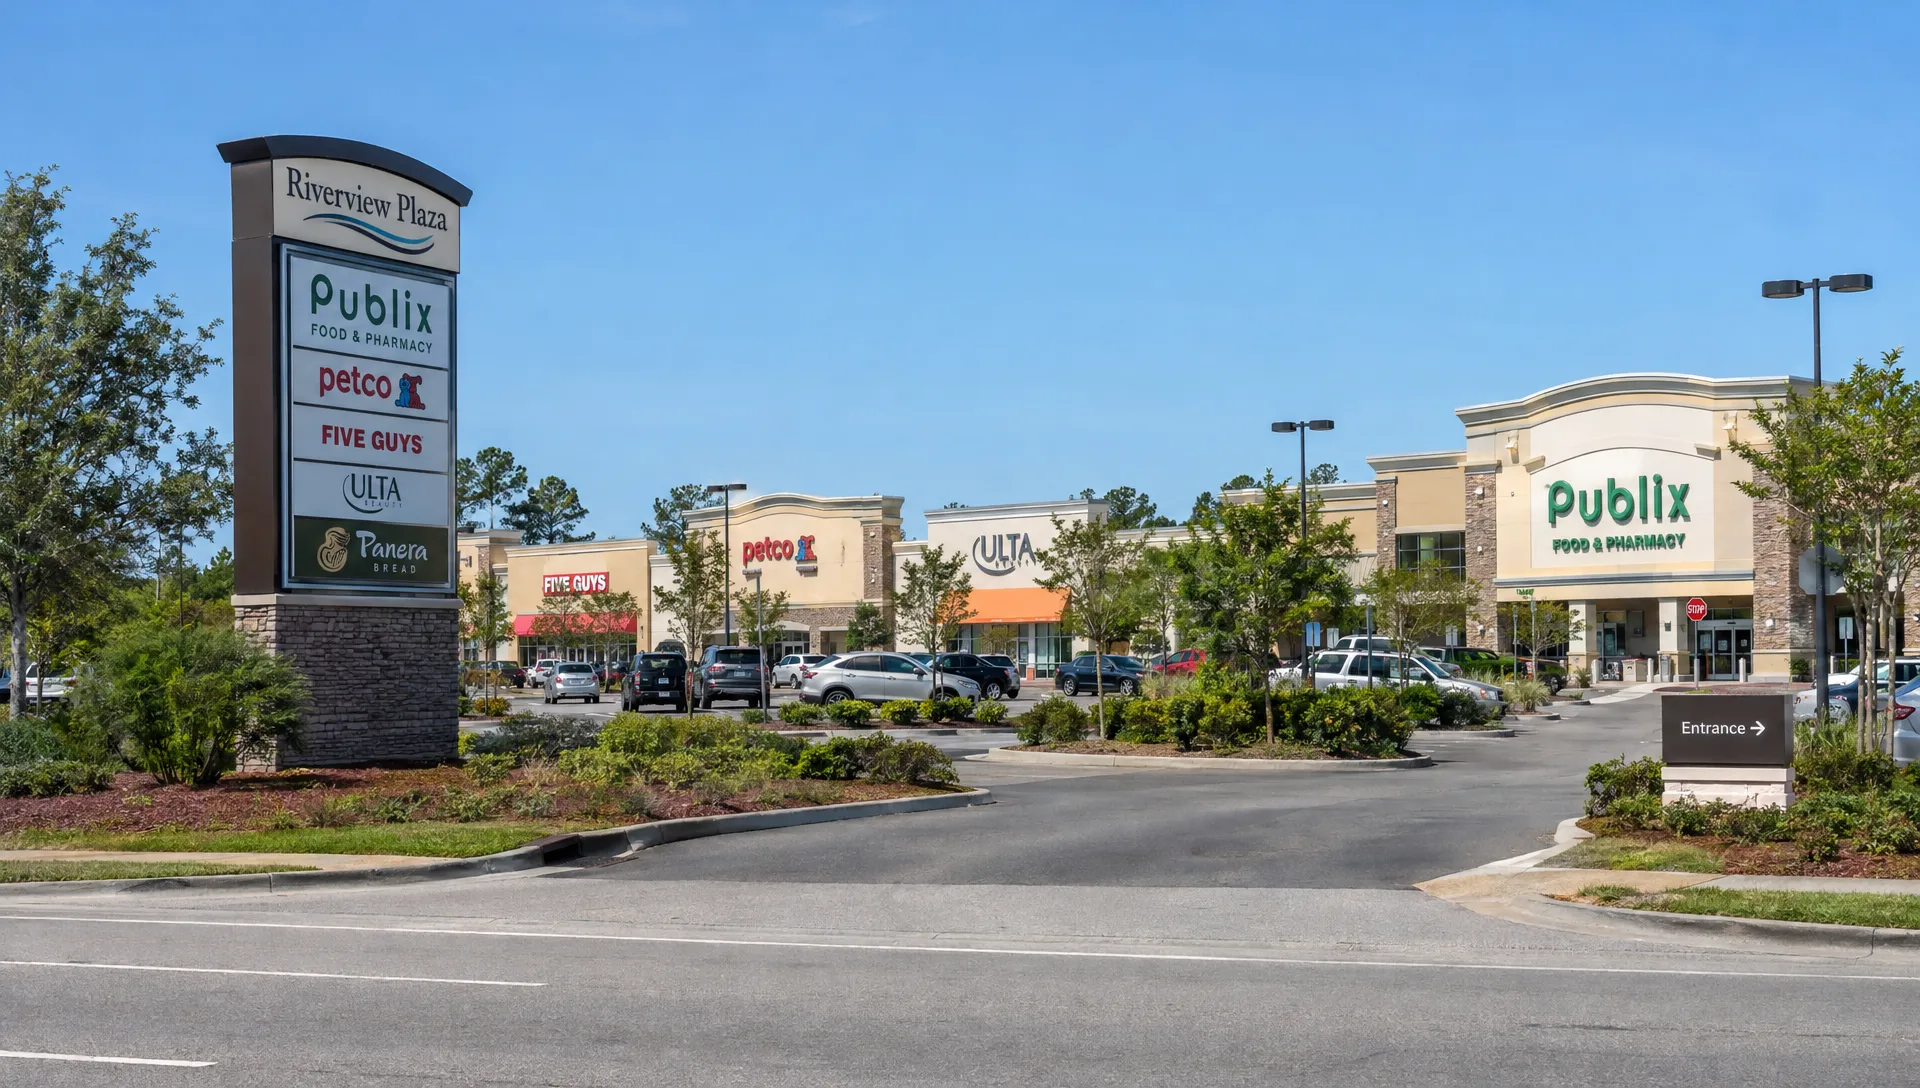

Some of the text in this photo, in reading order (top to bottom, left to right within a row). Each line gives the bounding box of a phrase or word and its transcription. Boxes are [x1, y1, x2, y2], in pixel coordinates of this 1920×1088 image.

[286, 166, 448, 231] Riverview Plaza
[311, 273, 433, 334] Publix
[311, 323, 433, 354] FOOD & PHARMACY
[319, 366, 392, 399] petco
[321, 424, 423, 455] FIVE GUYS
[351, 473, 402, 502] ULTA
[1548, 473, 1690, 524] Publix
[356, 530, 428, 561] Panera
[742, 536, 795, 568] petco
[980, 533, 1036, 564] ULTA
[1552, 533, 1686, 552] FOOD & PHARMACY
[373, 563, 416, 574] BREAD
[544, 574, 606, 593] FIVE GUYS
[1682, 721, 1746, 735] Entrance
